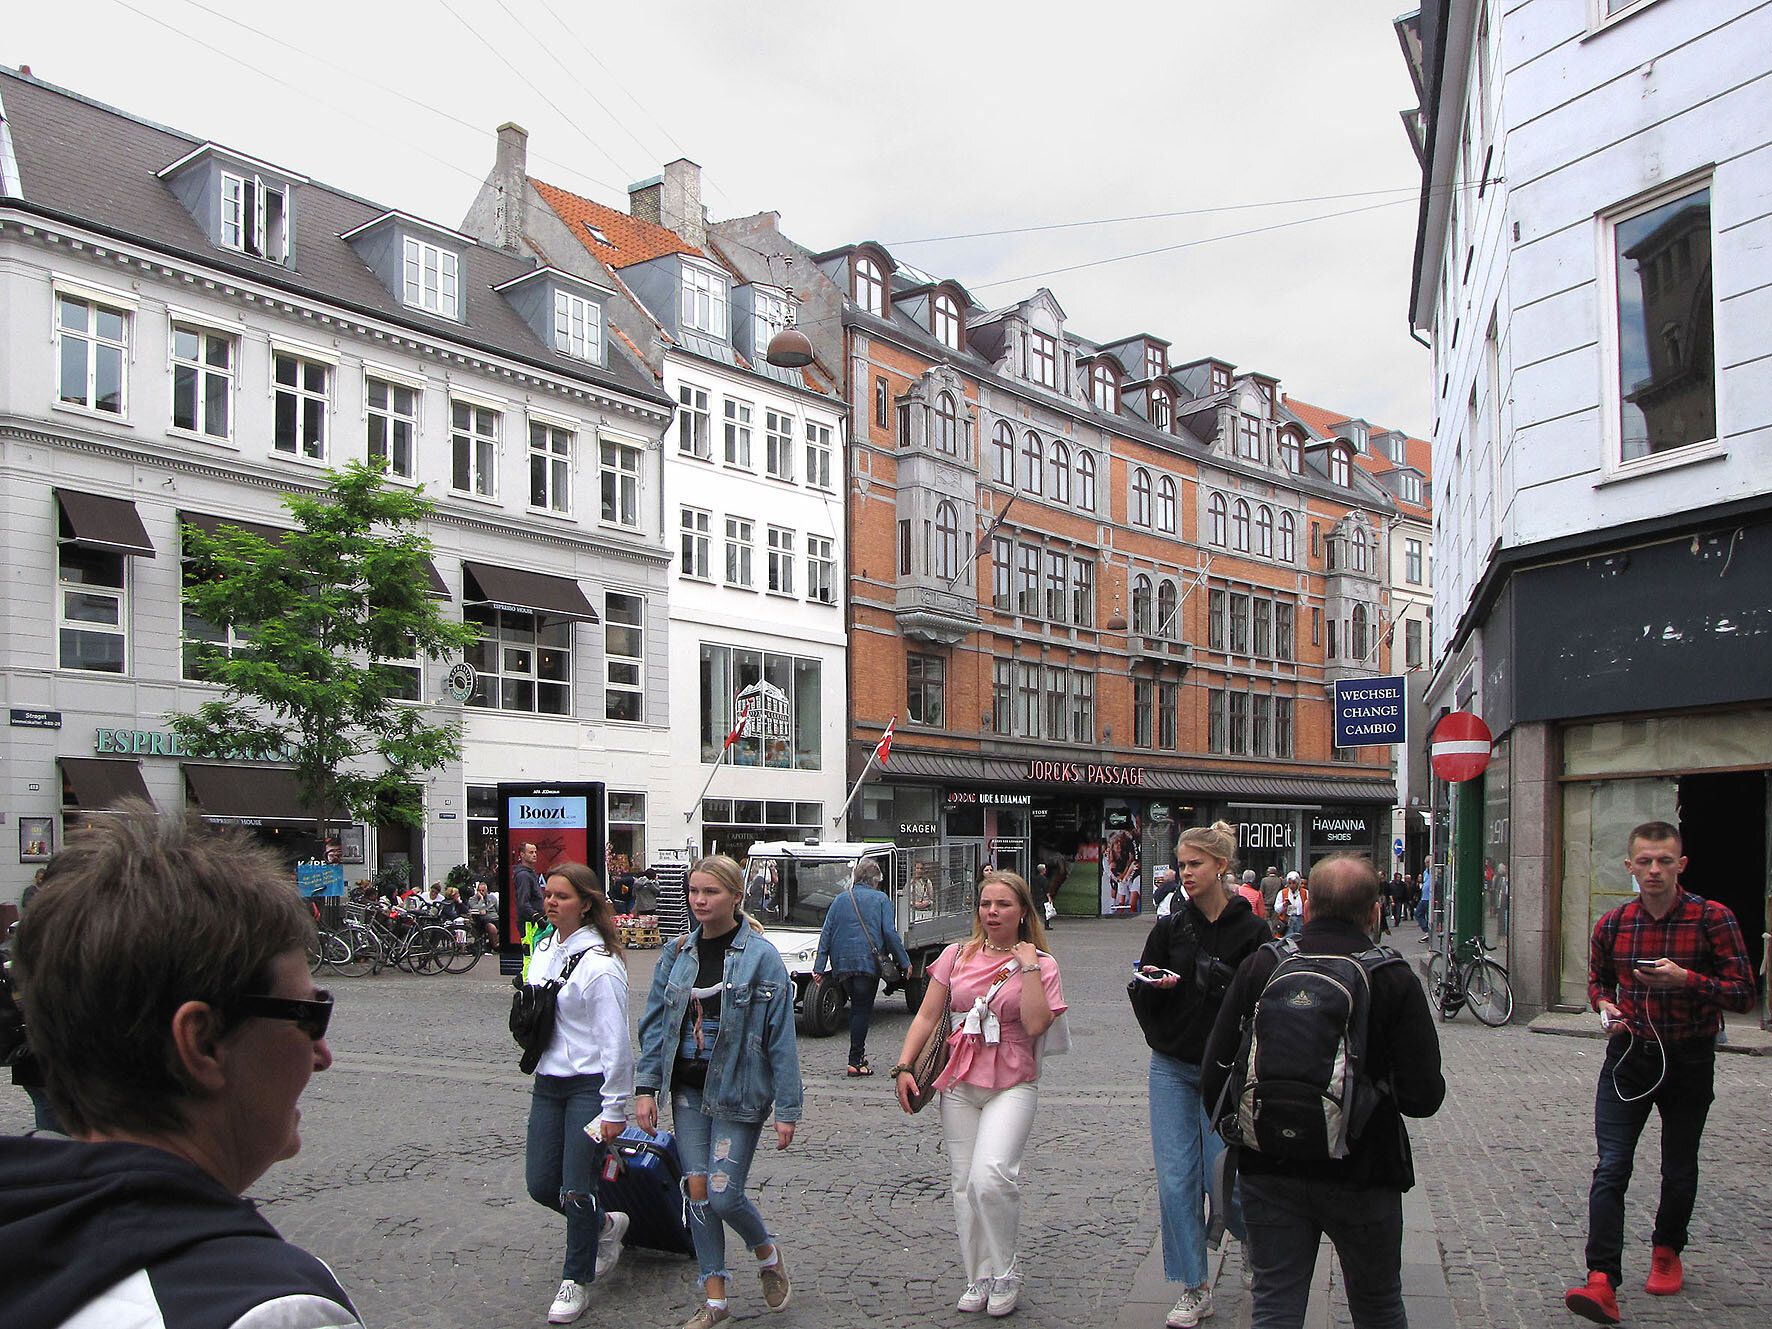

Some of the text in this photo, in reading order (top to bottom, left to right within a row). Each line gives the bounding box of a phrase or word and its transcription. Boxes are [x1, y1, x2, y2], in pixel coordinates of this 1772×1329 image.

[1341, 688, 1400, 701] WECHSEL
[1343, 705, 1398, 718] CHANGE
[1345, 723, 1397, 735] CAMBIO
[1027, 760, 1146, 785] JORCKS PASSAGE
[980, 793, 994, 804] URE
[1000, 794, 1032, 805] DIAMANT
[482, 826, 498, 835] DET
[900, 823, 936, 833] SKAGEN
[1313, 819, 1366, 831] HAVANNA
[1327, 833, 1352, 841] SHOES
